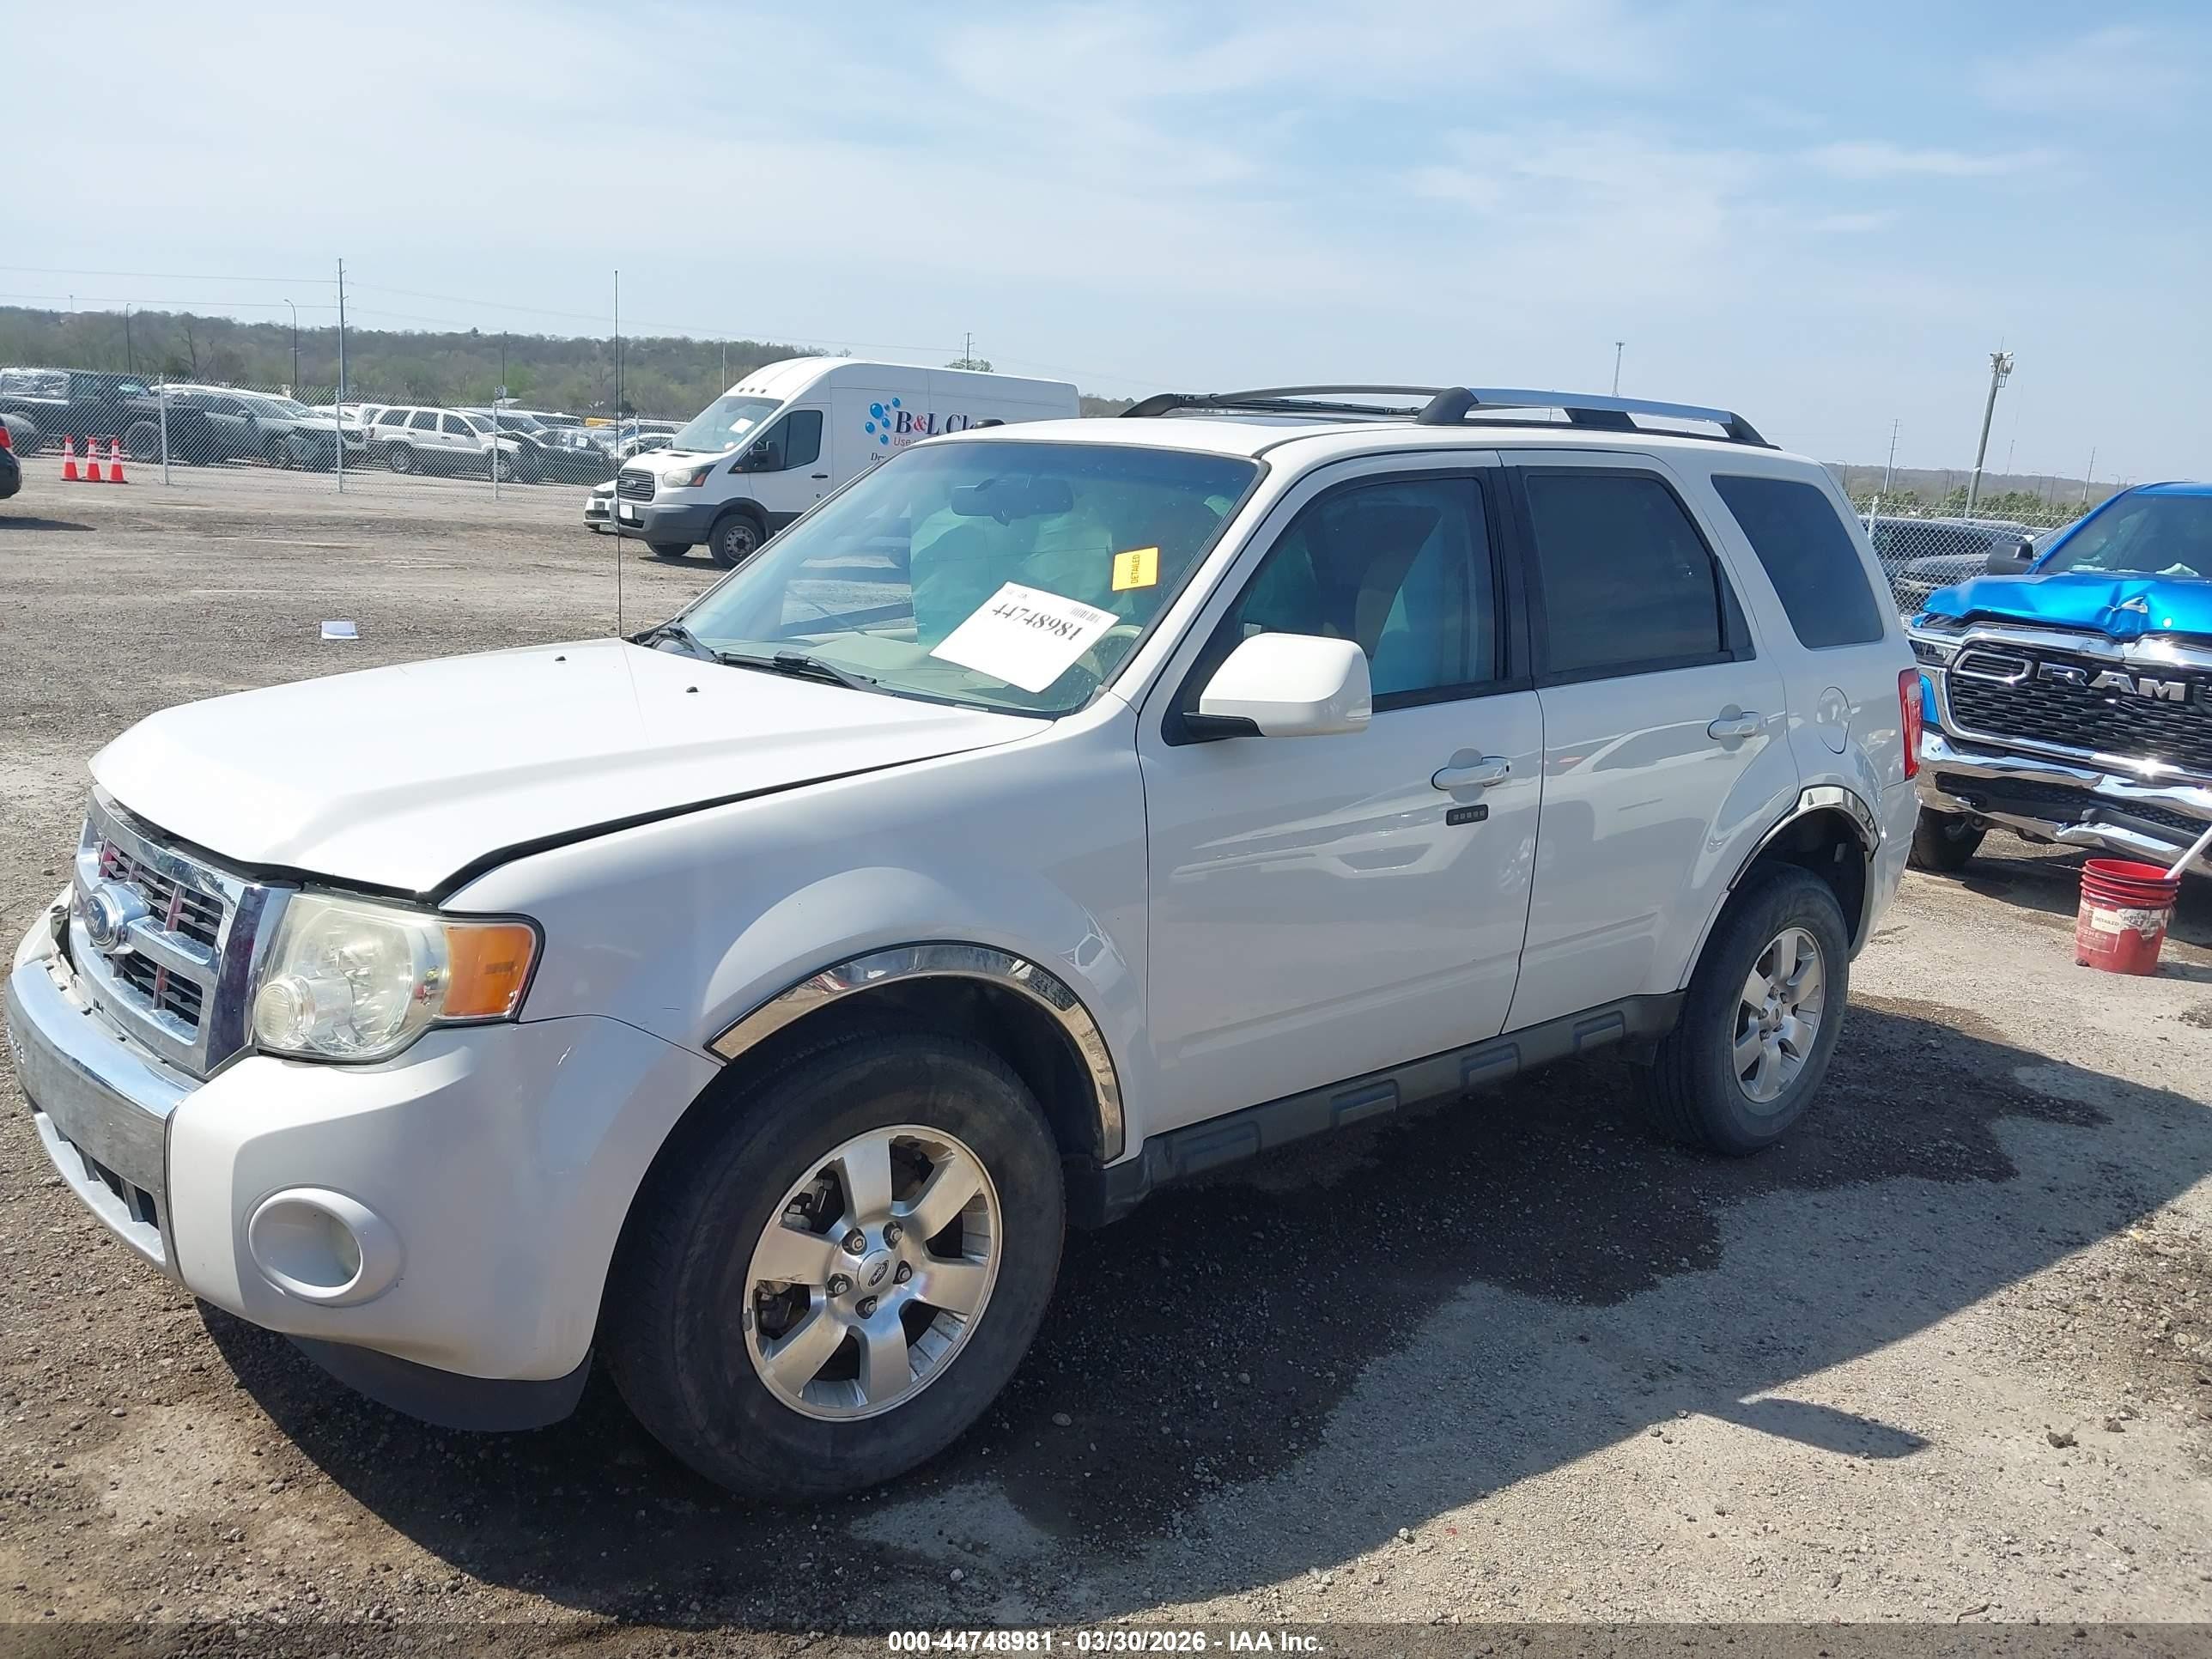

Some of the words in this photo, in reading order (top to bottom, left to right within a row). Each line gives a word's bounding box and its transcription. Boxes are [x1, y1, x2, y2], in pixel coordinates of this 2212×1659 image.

[894, 410, 940, 435] B&L
[1130, 554, 1140, 584] DETAILED
[992, 603, 1083, 641] 44748981
[2037, 661, 2186, 702] RAM
